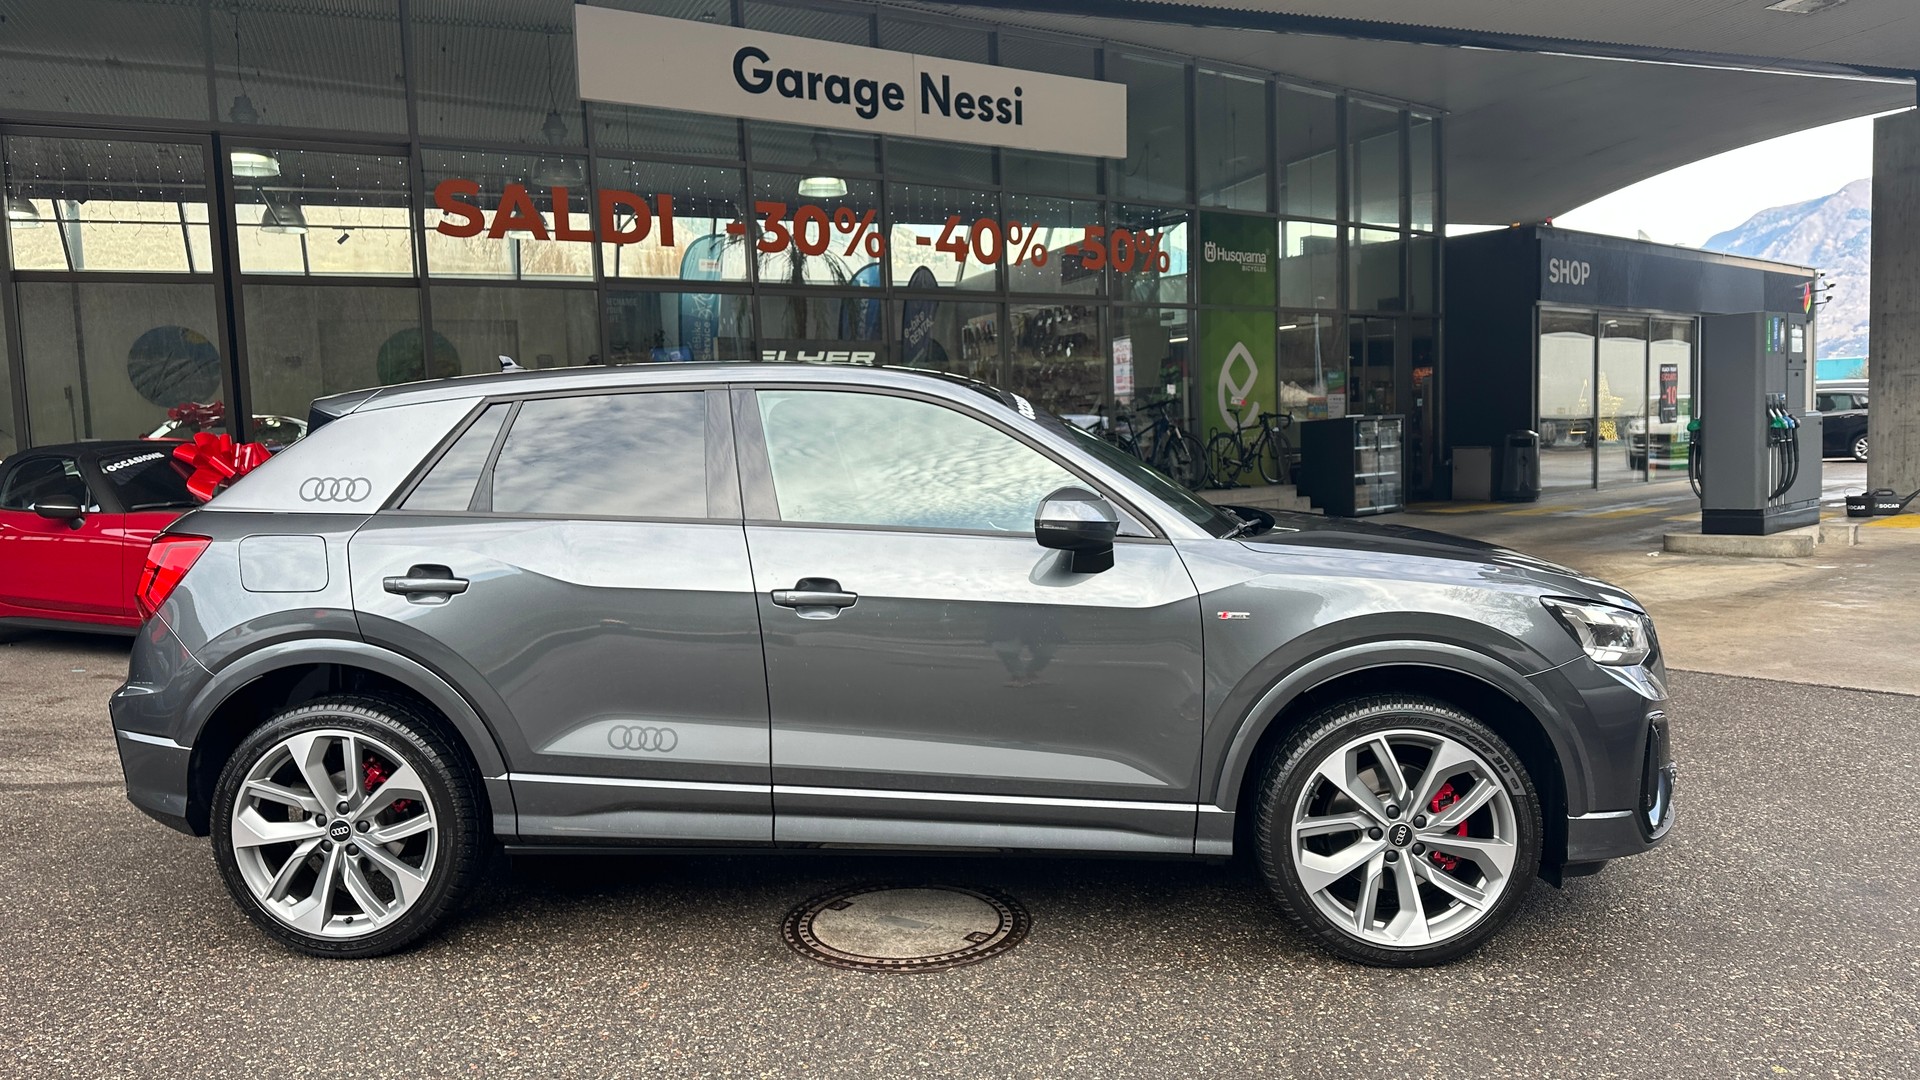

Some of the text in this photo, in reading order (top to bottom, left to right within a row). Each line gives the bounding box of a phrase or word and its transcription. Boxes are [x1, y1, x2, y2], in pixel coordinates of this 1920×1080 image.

[733, 46, 1023, 126] Garage Nessi
[434, 179, 1170, 272] SALDI -30% -40% -50%
[1217, 247, 1267, 264] Husqvarna
[1549, 257, 1591, 286] SHOP
[703, 321, 711, 361] Service
[106, 452, 165, 472] OCCASIONE
